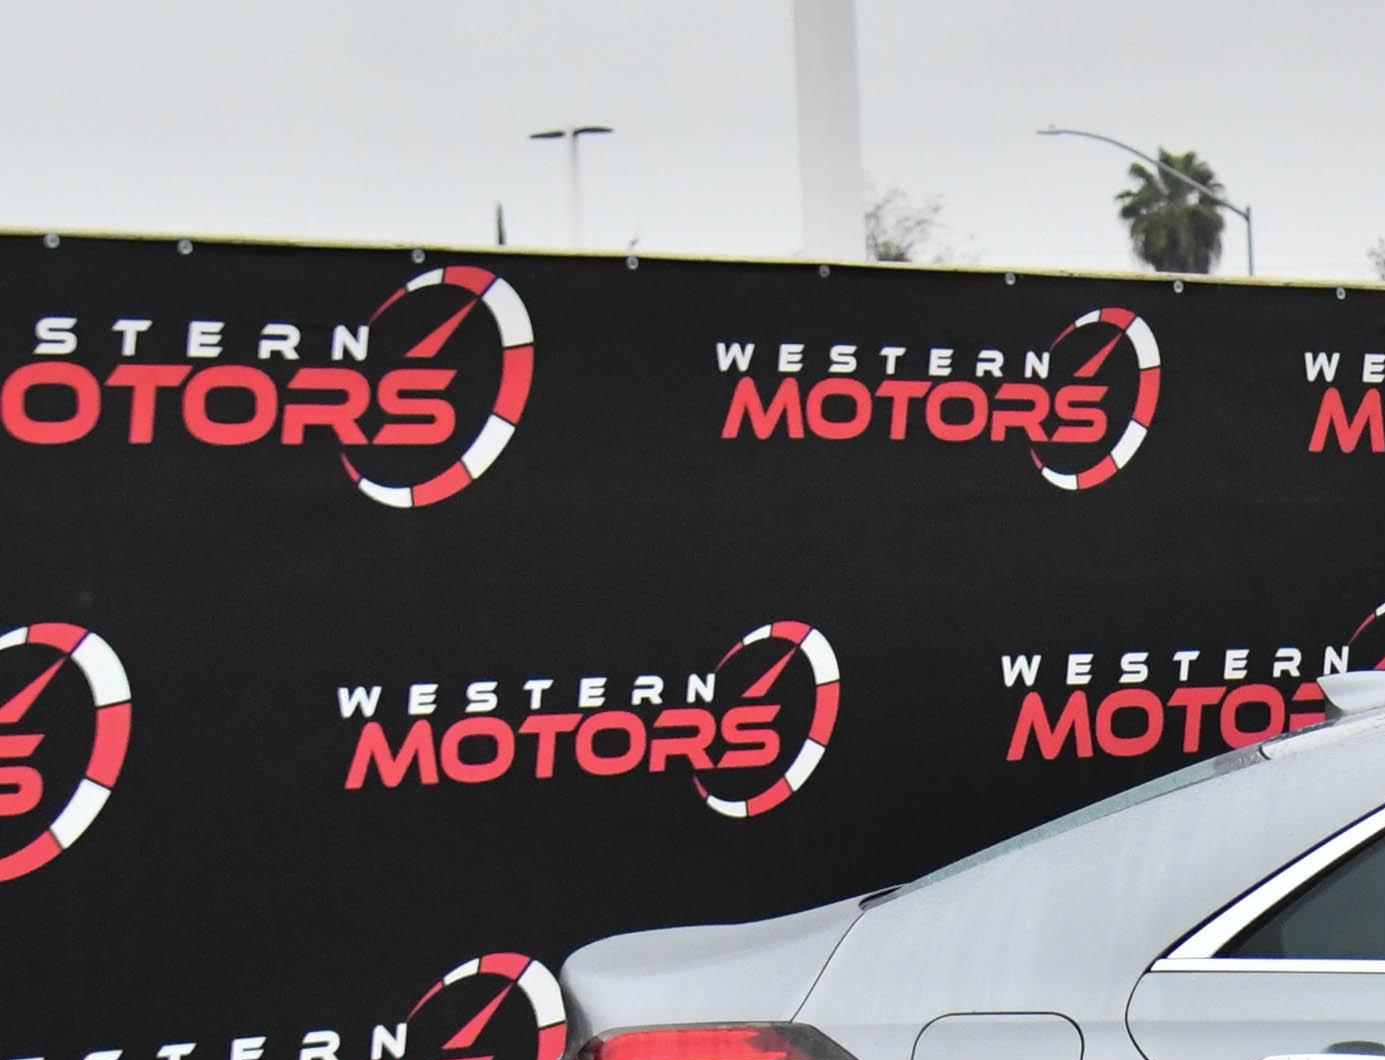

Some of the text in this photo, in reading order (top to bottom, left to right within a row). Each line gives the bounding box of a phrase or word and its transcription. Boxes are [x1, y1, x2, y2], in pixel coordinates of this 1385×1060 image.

[33, 317, 370, 361] STERN
[716, 342, 1050, 379] WESTERN
[721, 376, 1108, 444] MOTORS
[1001, 645, 1350, 688] WESTERN
[337, 672, 716, 719] WESTERN
[344, 704, 781, 790] MOTORS
